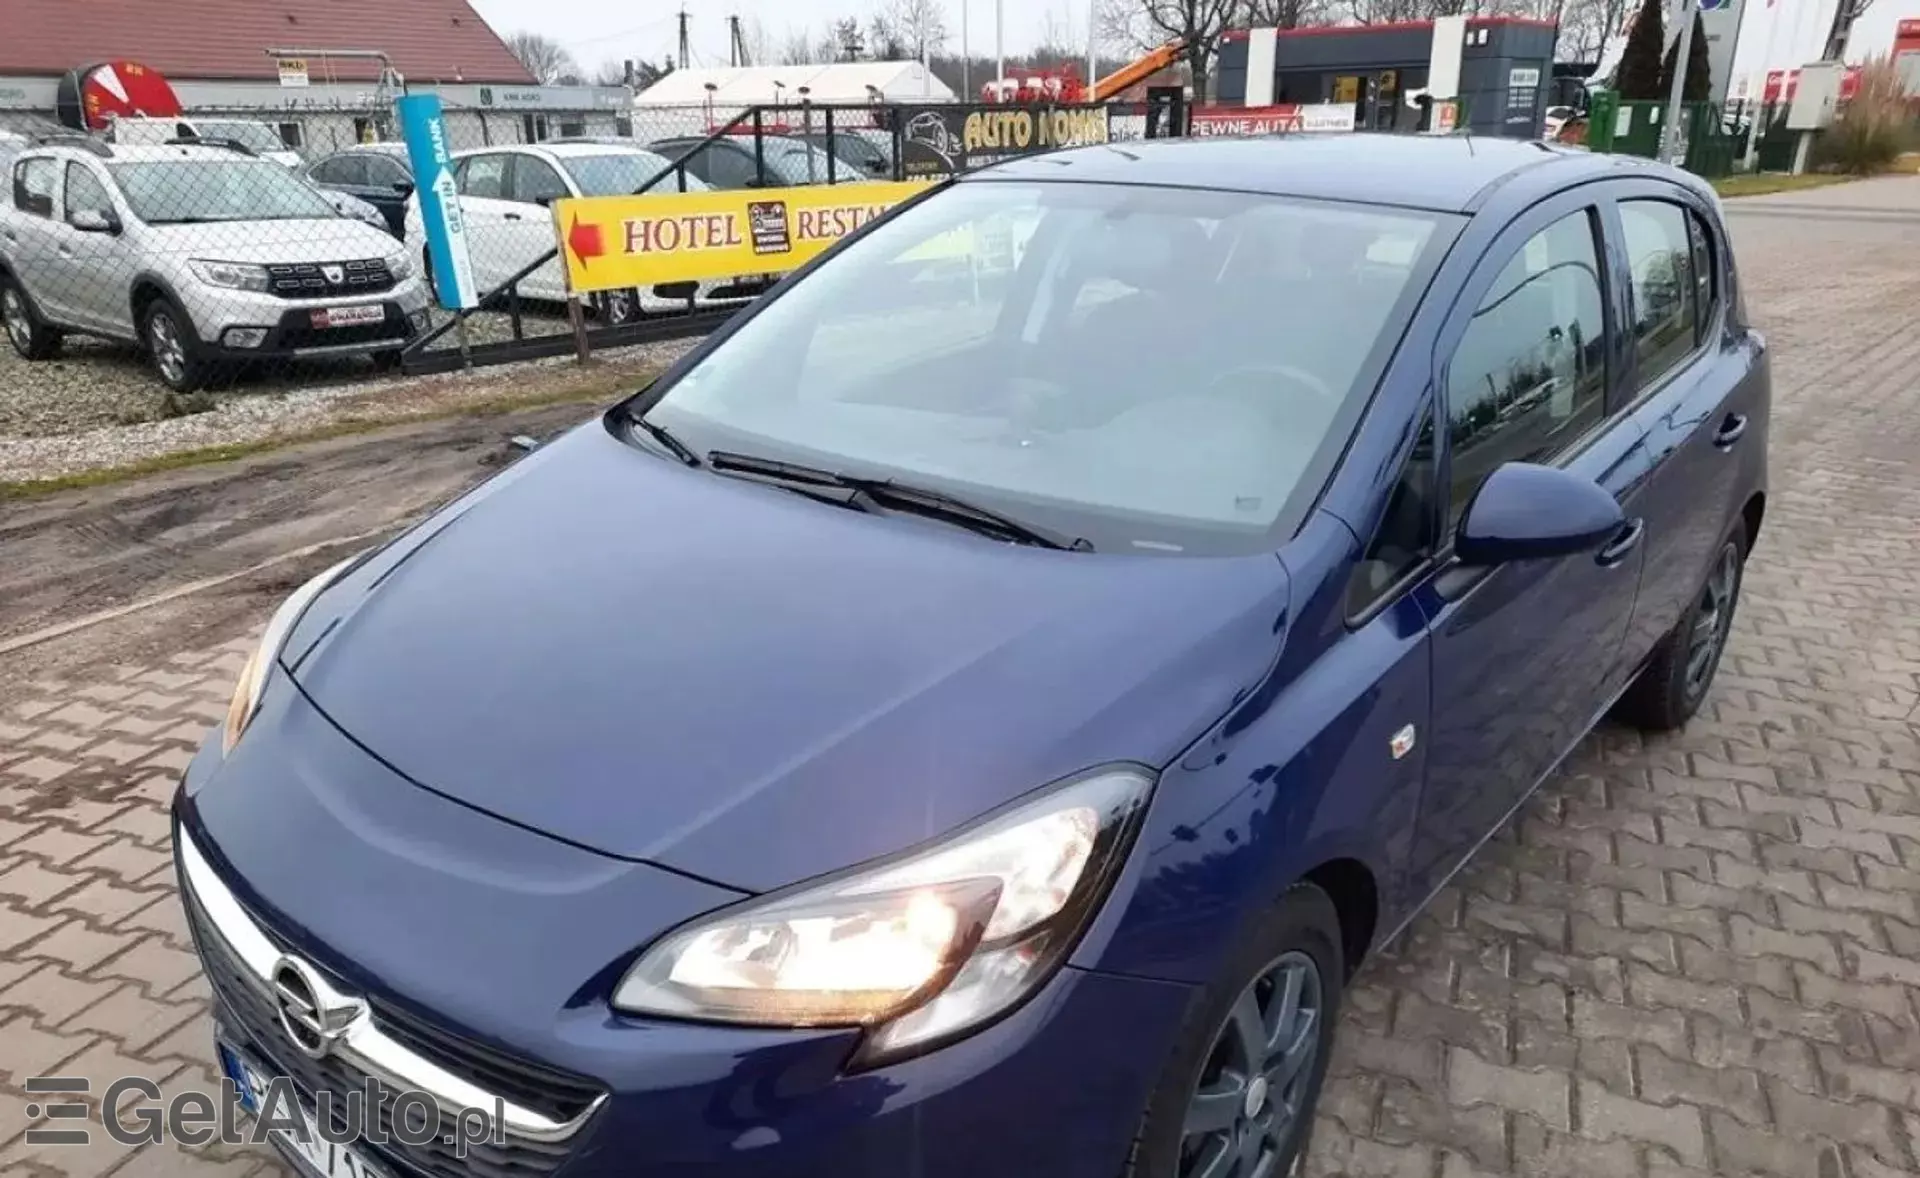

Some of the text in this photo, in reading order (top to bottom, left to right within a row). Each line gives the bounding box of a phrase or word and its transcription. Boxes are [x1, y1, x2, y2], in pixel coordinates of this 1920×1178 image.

[964, 110, 1032, 150] AUTO
[427, 117, 461, 234] GET IN BANK
[624, 215, 742, 254] HOTEL
